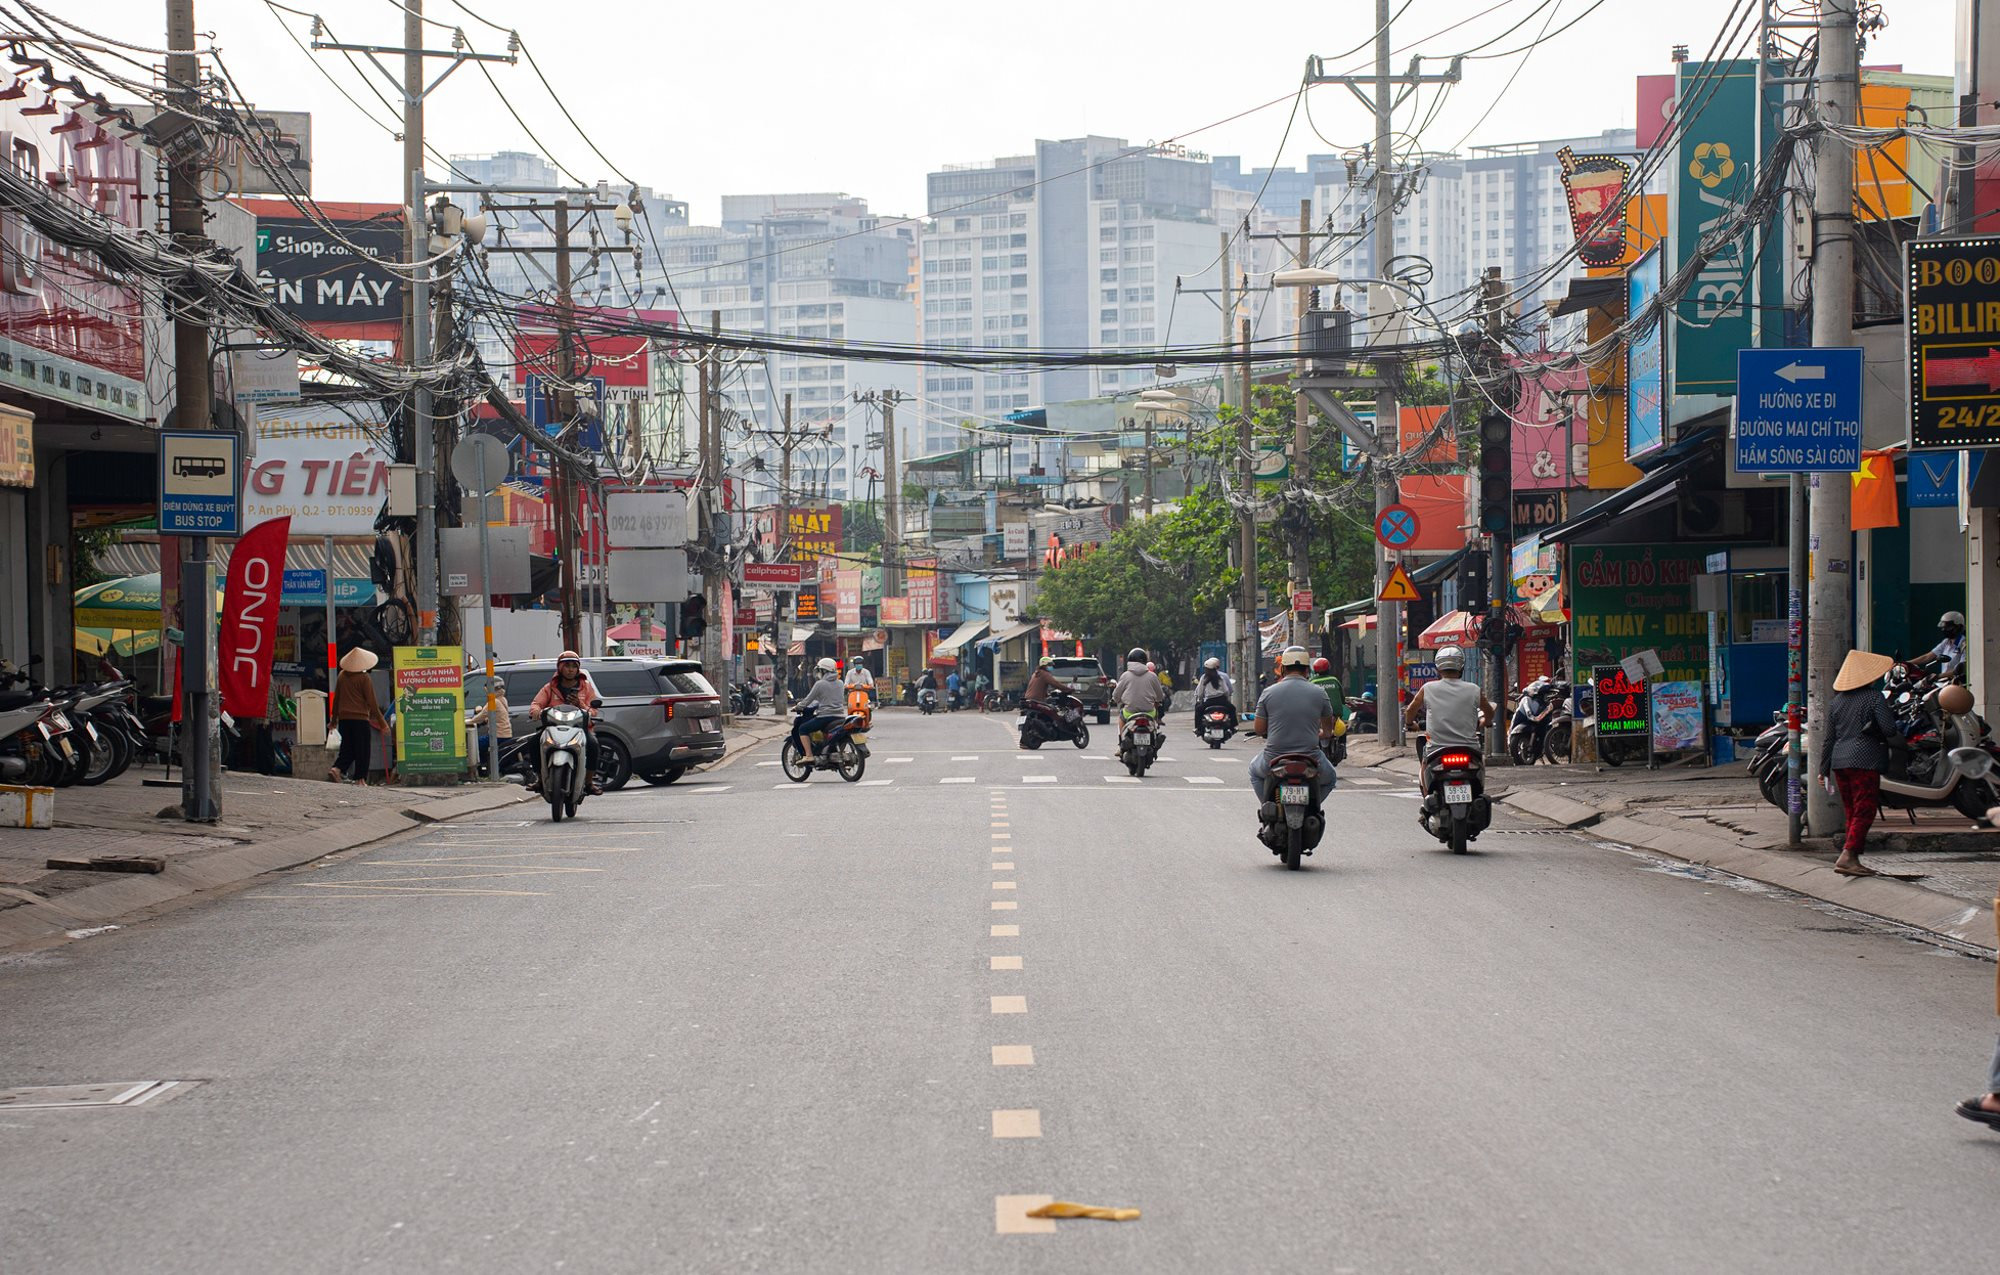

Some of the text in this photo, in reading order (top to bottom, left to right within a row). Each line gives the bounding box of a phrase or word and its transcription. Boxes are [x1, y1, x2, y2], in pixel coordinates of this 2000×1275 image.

[317, 272, 393, 306] MÁY
[626, 353, 639, 371] S
[624, 387, 648, 401] TÍNH
[1759, 388, 1836, 409] HƯỚNG XE ĐI
[1740, 415, 1859, 440] ĐƯỜNG MAI CHÍ THỌ
[1740, 443, 1855, 465] HẦM SÔNG SÀI GÒN
[205, 503, 215, 512] XE
[260, 504, 274, 515] An
[302, 504, 320, 517] Q.2
[1534, 494, 1556, 525] ĐỒ
[175, 515, 223, 527] BUS STOP
[612, 516, 636, 531] 0922
[788, 507, 831, 534] MẮT
[746, 567, 798, 576] cellphone S
[1577, 549, 1622, 588] CẦM
[1626, 548, 1656, 587] ĐỒ
[232, 557, 270, 689] JUNO
[1577, 615, 1600, 637] XE
[1605, 612, 1646, 637] MÁY
[629, 647, 663, 656] viettel
[402, 670, 420, 678] VIỆC
[439, 676, 459, 684] ĐỊNH
[411, 696, 450, 705] NHÂN VIÊN
[1607, 694, 1638, 719] ĐỒ
[424, 727, 431, 736] 9
[1601, 720, 1646, 731] KHAI MINH
